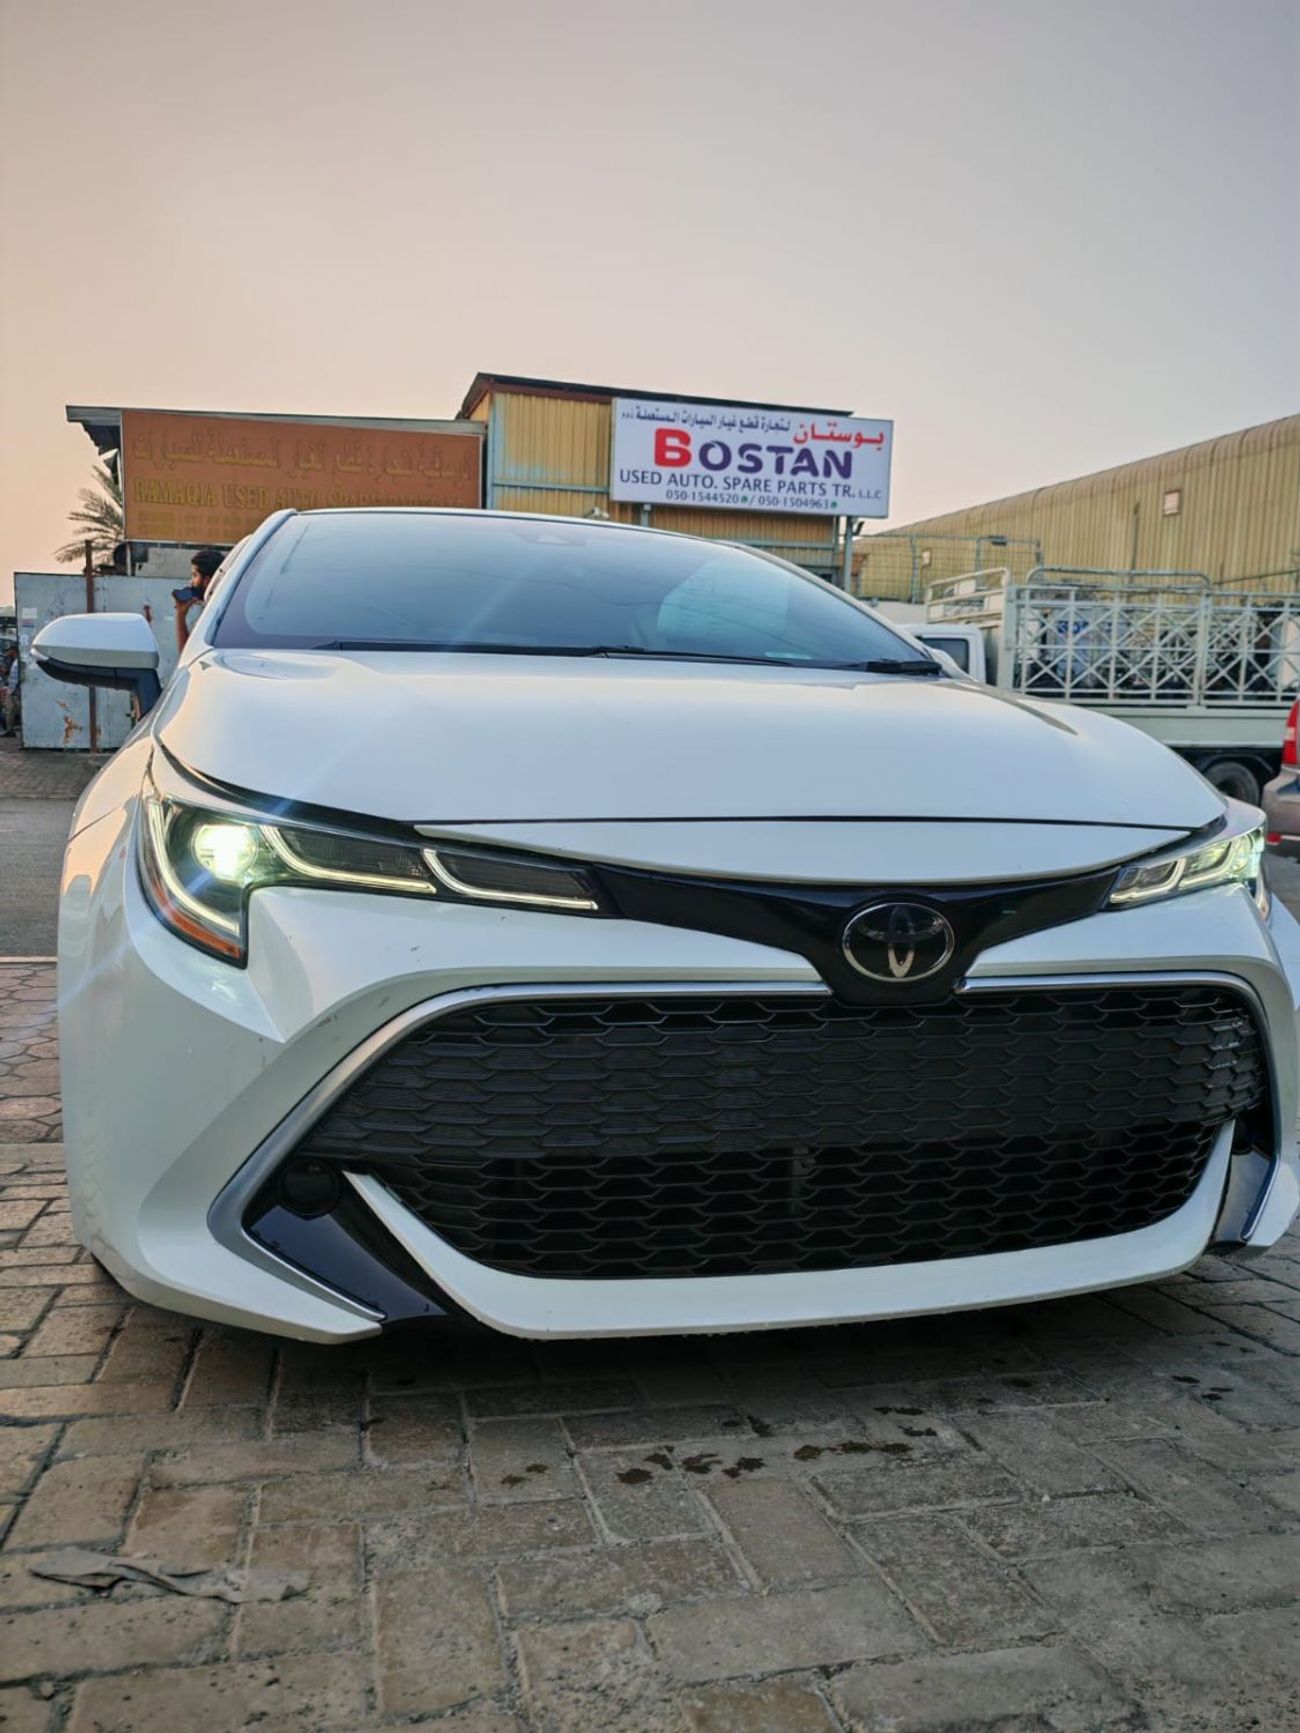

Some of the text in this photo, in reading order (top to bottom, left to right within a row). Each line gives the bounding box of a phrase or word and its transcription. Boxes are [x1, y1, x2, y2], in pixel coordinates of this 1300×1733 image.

[717, 414, 737, 431] غيار
[738, 415, 759, 433] قطع
[793, 421, 885, 451] بوستان
[654, 427, 853, 480] BOSTAN
[134, 479, 218, 507] RAMAQIA
[222, 483, 270, 510] USED
[620, 469, 662, 485] USED
[722, 476, 772, 493] SPARE
[777, 480, 827, 496] PARTS
